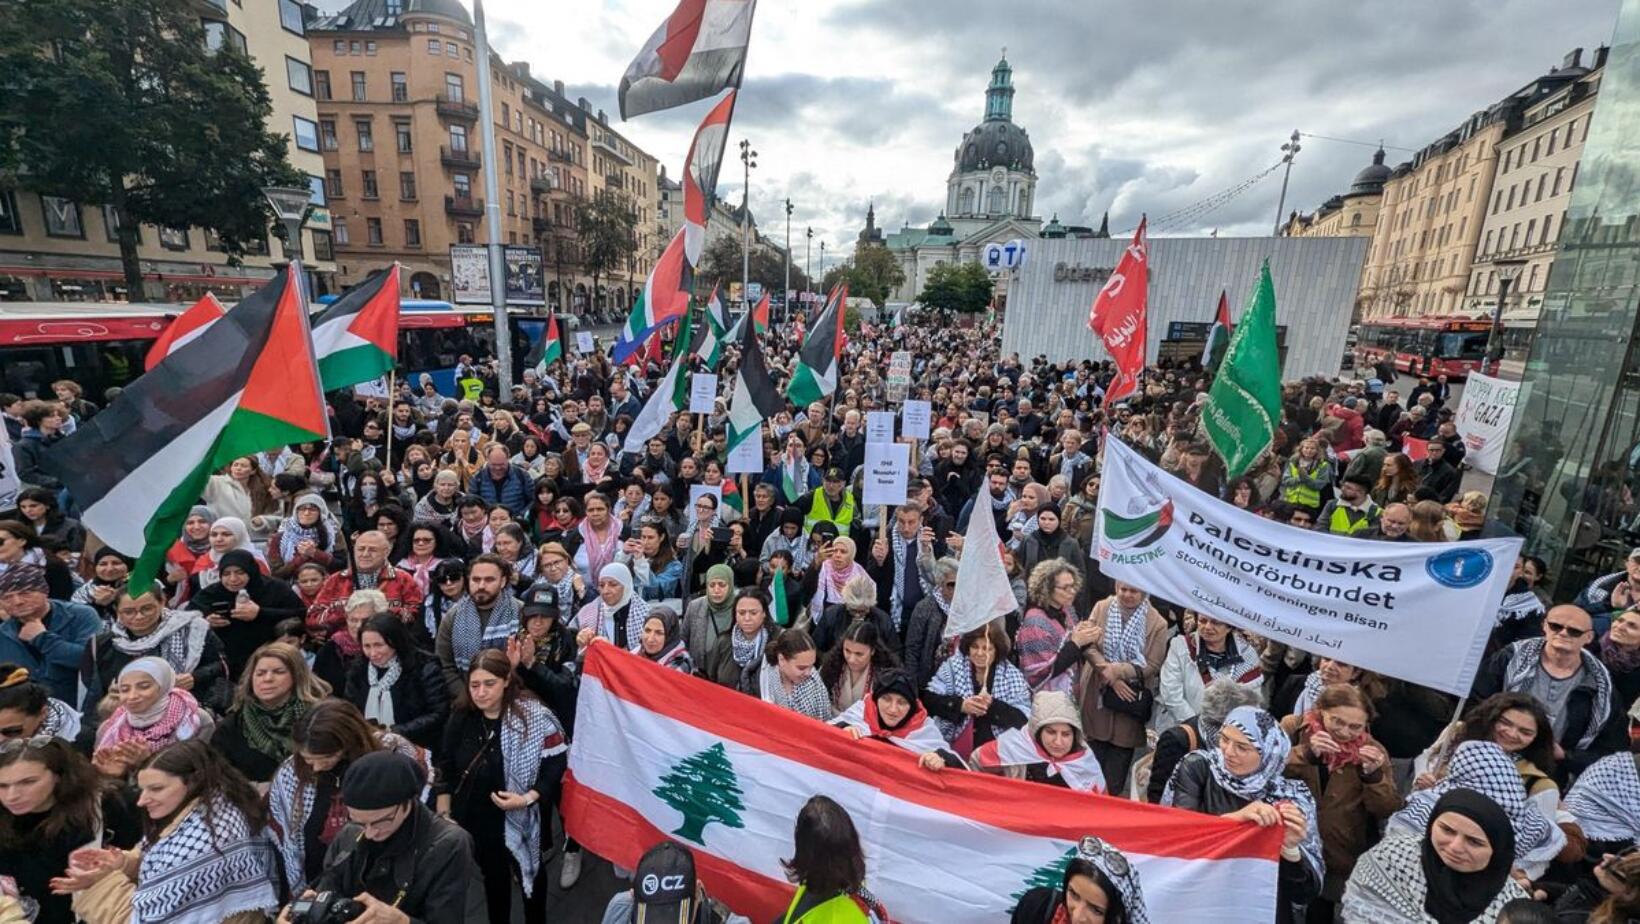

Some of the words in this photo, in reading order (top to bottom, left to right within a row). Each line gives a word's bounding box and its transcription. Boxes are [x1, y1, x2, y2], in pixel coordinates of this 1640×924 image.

[1005, 247, 1017, 265] T
[1474, 402, 1504, 427] GAZA
[1112, 545, 1166, 565] PALESTINE
[1189, 511, 1402, 582] Palestinska
[1183, 531, 1395, 610] Kvinnoförbundet
[1175, 550, 1241, 585] Stockholm
[1343, 612, 1389, 631] Bisan
[1191, 585, 1262, 623] الفلسطينية
[1263, 616, 1302, 637] المرأة
[1304, 633, 1343, 650] اتحاد
[661, 875, 685, 891] CZ
